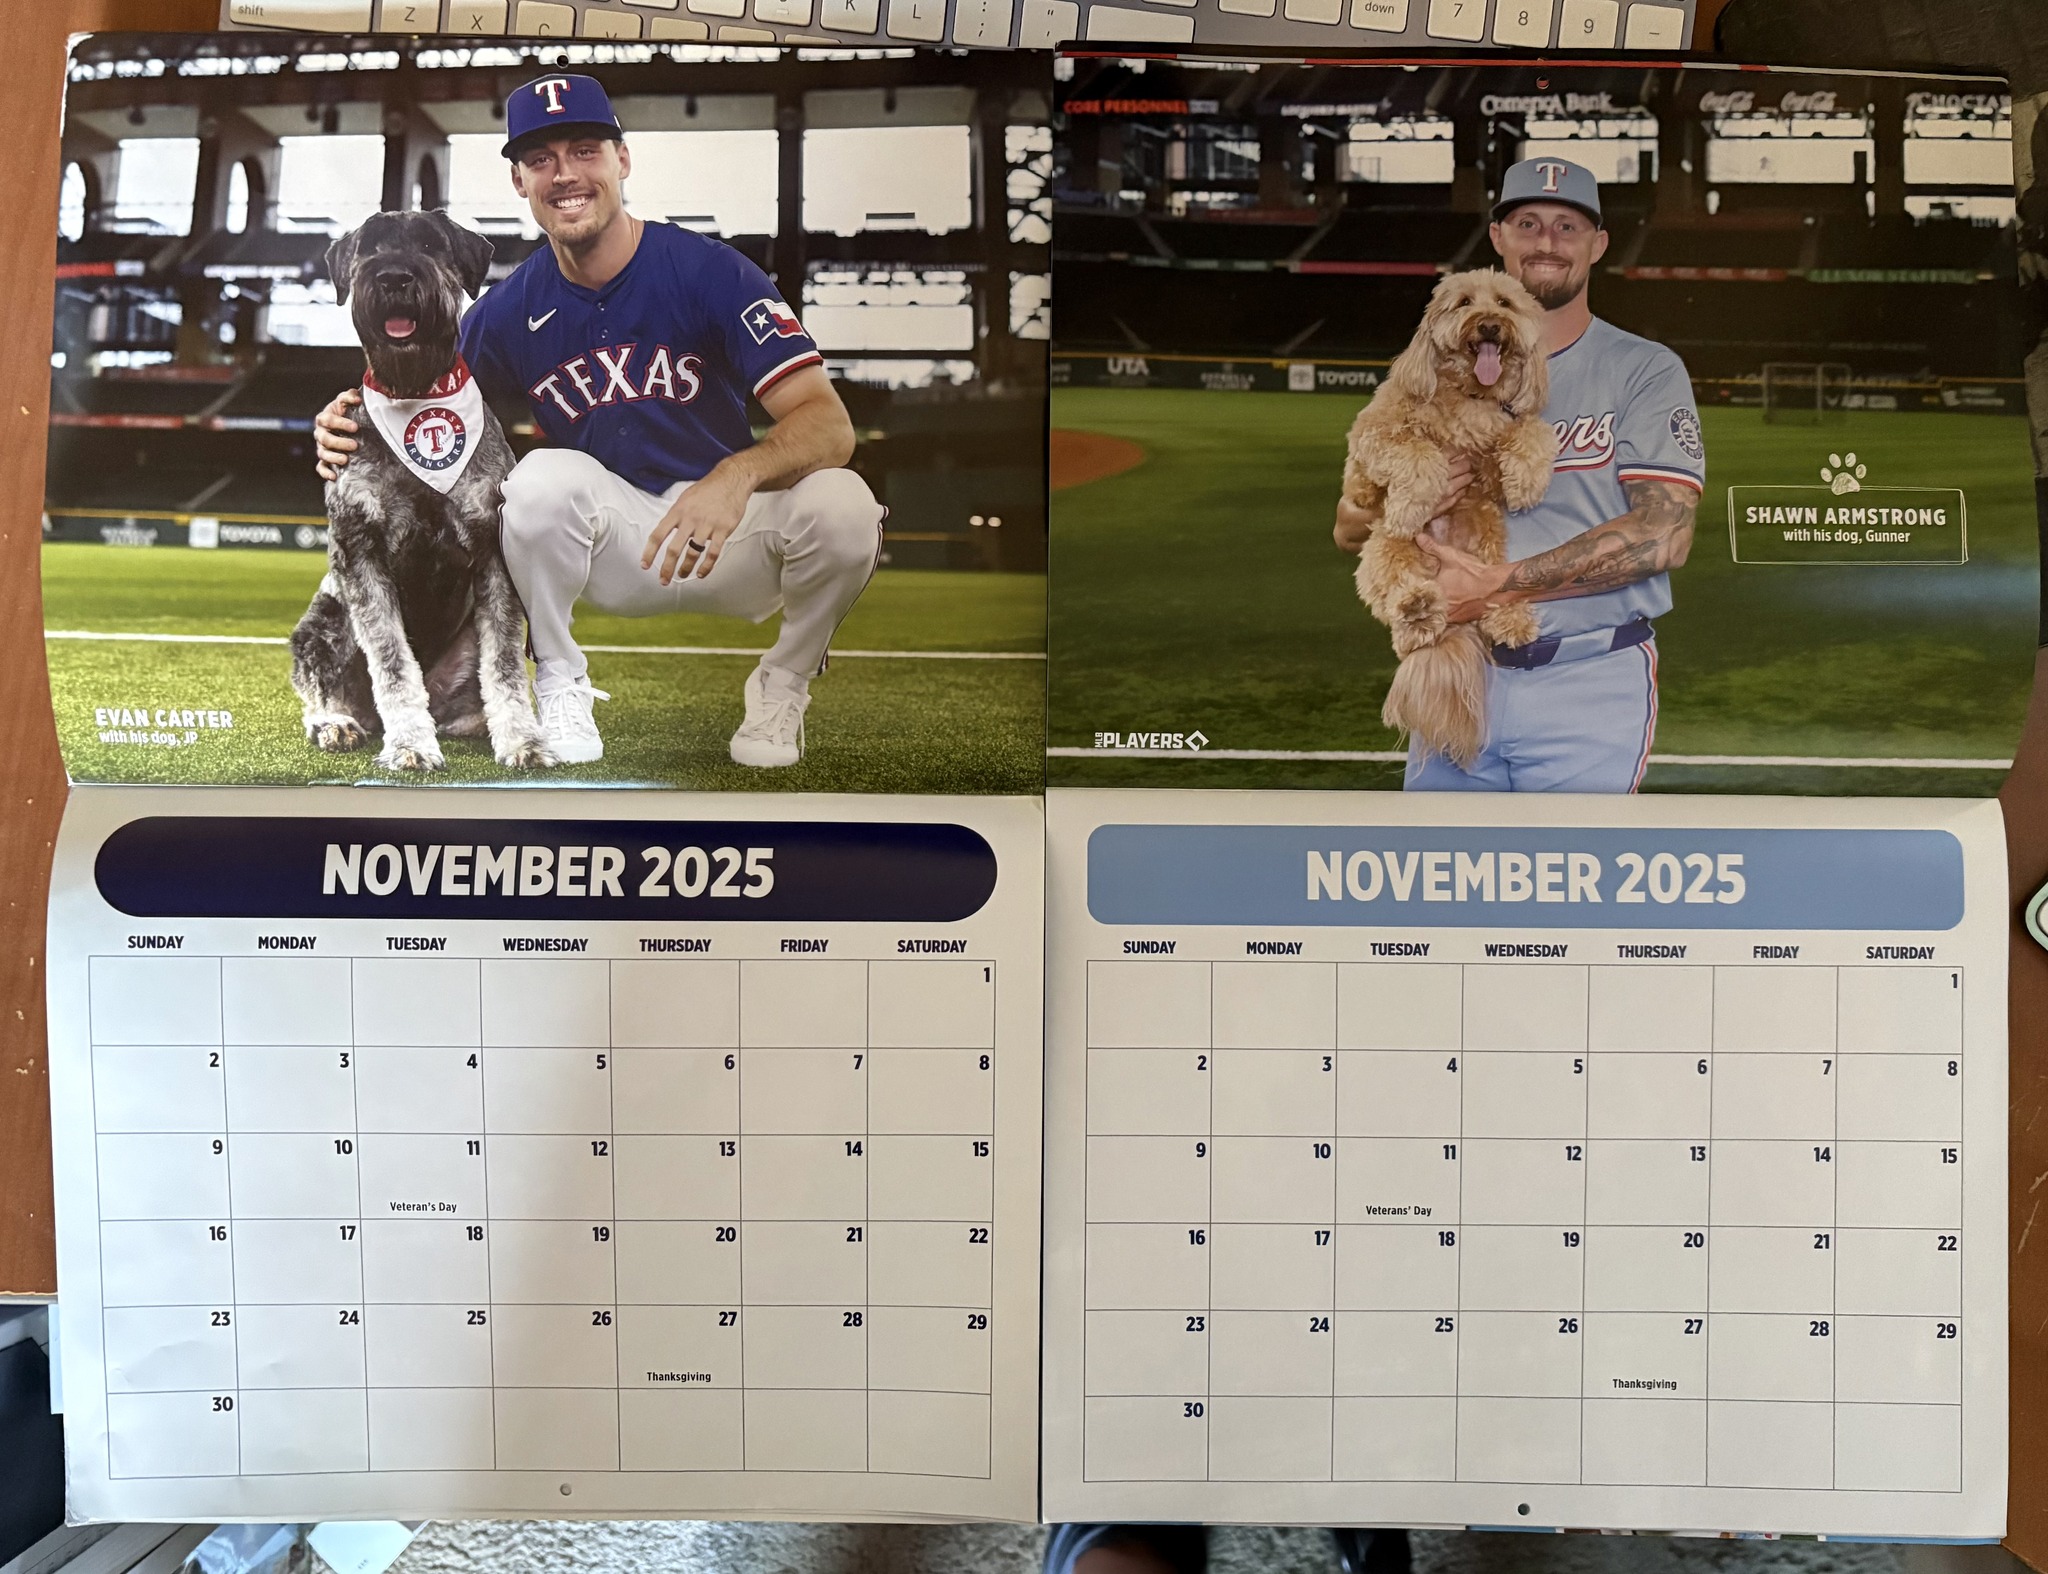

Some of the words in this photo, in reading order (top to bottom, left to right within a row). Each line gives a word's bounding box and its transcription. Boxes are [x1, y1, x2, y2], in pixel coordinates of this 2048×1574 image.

[237, 3, 265, 17] shift
[404, 7, 416, 22] Z
[912, 4, 922, 19] L
[1364, 1, 1396, 15] down
[1451, 3, 1463, 18] 7
[471, 15, 484, 31] X
[1517, 11, 1529, 27] 8
[1583, 19, 1595, 35] 9
[535, 79, 571, 115] T
[1536, 163, 1568, 194] T
[529, 343, 704, 423] TEXAS
[1317, 370, 1378, 386] TOYOTA
[422, 425, 447, 454] T
[1746, 506, 1817, 524] SHAWN
[1824, 508, 1946, 526] ARMSTRONG
[1783, 529, 1810, 542] with
[1813, 529, 1832, 542] his
[1834, 529, 1862, 545] dog,
[1865, 530, 1911, 543] Gunner
[95, 708, 150, 727] EVAN
[155, 710, 234, 728] CARTER
[99, 729, 128, 743] with
[130, 730, 149, 744] his
[151, 731, 181, 746] dog,
[184, 731, 198, 744] JP
[1103, 732, 1184, 749] PLAYERS
[322, 843, 625, 897] NOVEMBER
[639, 846, 775, 898] 2025
[1306, 850, 1603, 903] NOVEMBER
[1615, 852, 1746, 904] 2025
[127, 935, 185, 950] SUNDAY
[257, 935, 318, 950] MONDAY
[386, 937, 447, 951] TUESDAY
[503, 937, 589, 952] WEDNESDAY
[639, 938, 712, 953] THURSDAY
[780, 938, 830, 953] FRIDAY
[896, 939, 968, 954] SATURDAY
[1122, 940, 1177, 955] SUNDAY
[1246, 941, 1303, 956] MONDAY
[1369, 942, 1431, 957] TUESDAY
[1484, 943, 1569, 958] WEDNESDAY
[1617, 944, 1687, 959] THURSDAY
[1752, 945, 1800, 959] FRIDAY
[1866, 945, 1935, 960] SATURDAY
[983, 966, 991, 983] 1
[1950, 973, 1958, 989] 1
[208, 1051, 220, 1068] 2
[339, 1052, 350, 1069] 3
[466, 1053, 479, 1070] 4
[596, 1053, 607, 1070] 5
[724, 1053, 736, 1071] 6
[853, 1054, 864, 1071] 7
[978, 1054, 990, 1071] 8
[1197, 1054, 1208, 1071] 2
[1321, 1055, 1332, 1072] 3
[1446, 1057, 1458, 1073] 4
[1573, 1058, 1584, 1075] 5
[1697, 1058, 1708, 1075] 6
[1822, 1059, 1833, 1076] 7
[1947, 1060, 1958, 1077] 8
[212, 1139, 224, 1155] 9
[333, 1138, 353, 1155] 10
[466, 1139, 481, 1156] 11
[590, 1140, 609, 1157] 12
[718, 1140, 736, 1157] 13
[844, 1140, 864, 1157] 14
[972, 1141, 990, 1158] 15
[1195, 1141, 1207, 1158] 9
[1312, 1142, 1332, 1160] 10
[1442, 1144, 1457, 1161] 11
[1565, 1145, 1583, 1162] 12
[1689, 1145, 1707, 1162] 13
[1813, 1146, 1832, 1163] 14
[1940, 1147, 1958, 1164] 15
[389, 1201, 437, 1212] Veteran's
[438, 1201, 457, 1214] Day
[1365, 1205, 1411, 1216] Veterans'
[1413, 1205, 1432, 1217] Day
[208, 1225, 227, 1242] 16
[339, 1224, 357, 1241] 17
[465, 1225, 484, 1242] 18
[592, 1226, 610, 1242] 19
[715, 1226, 737, 1243] 20
[846, 1226, 863, 1243] 21
[968, 1227, 989, 1244] 22
[1188, 1229, 1206, 1246] 16
[1314, 1229, 1331, 1246] 17
[1437, 1230, 1456, 1247] 18
[1562, 1231, 1581, 1248] 19
[1683, 1231, 1705, 1249] 20
[1813, 1233, 1830, 1250] 21
[1937, 1234, 1958, 1252] 22
[210, 1310, 231, 1327] 23
[338, 1309, 360, 1326] 24
[466, 1309, 487, 1326] 25
[591, 1310, 612, 1327] 26
[718, 1310, 738, 1327] 27
[842, 1311, 863, 1328] 28
[967, 1313, 988, 1331] 29
[1185, 1315, 1206, 1333] 23
[1309, 1316, 1330, 1333] 24
[1434, 1316, 1454, 1333] 25
[1558, 1317, 1579, 1334] 26
[1683, 1318, 1704, 1335] 27
[1809, 1320, 1830, 1337] 28
[1936, 1322, 1957, 1340] 29
[646, 1371, 712, 1383] Thanksgiving
[1612, 1378, 1678, 1391] Thanksgiving
[212, 1395, 234, 1412] 30
[1183, 1401, 1205, 1418] 30
